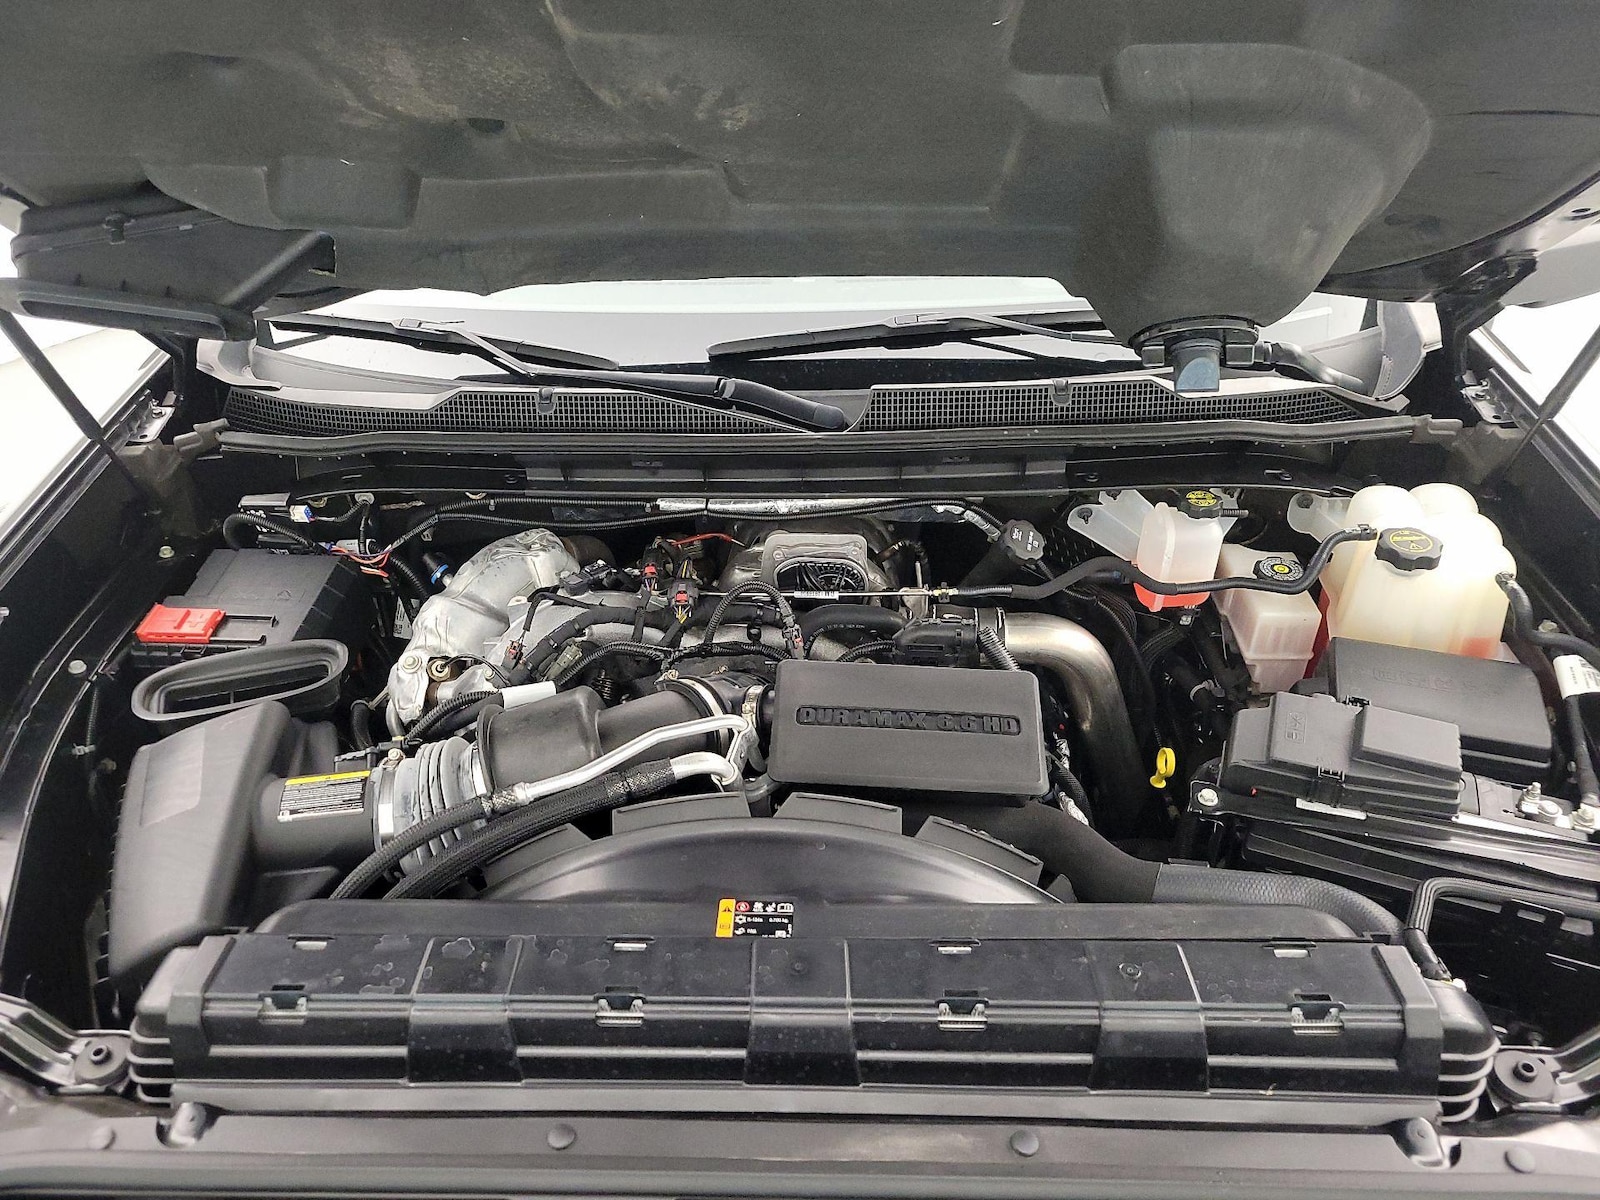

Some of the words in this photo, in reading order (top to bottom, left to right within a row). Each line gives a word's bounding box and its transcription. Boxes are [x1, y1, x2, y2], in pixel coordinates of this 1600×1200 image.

[800, 707, 927, 729] DURAMAX
[936, 714, 978, 731] 6.6
[983, 716, 1019, 733] HD
